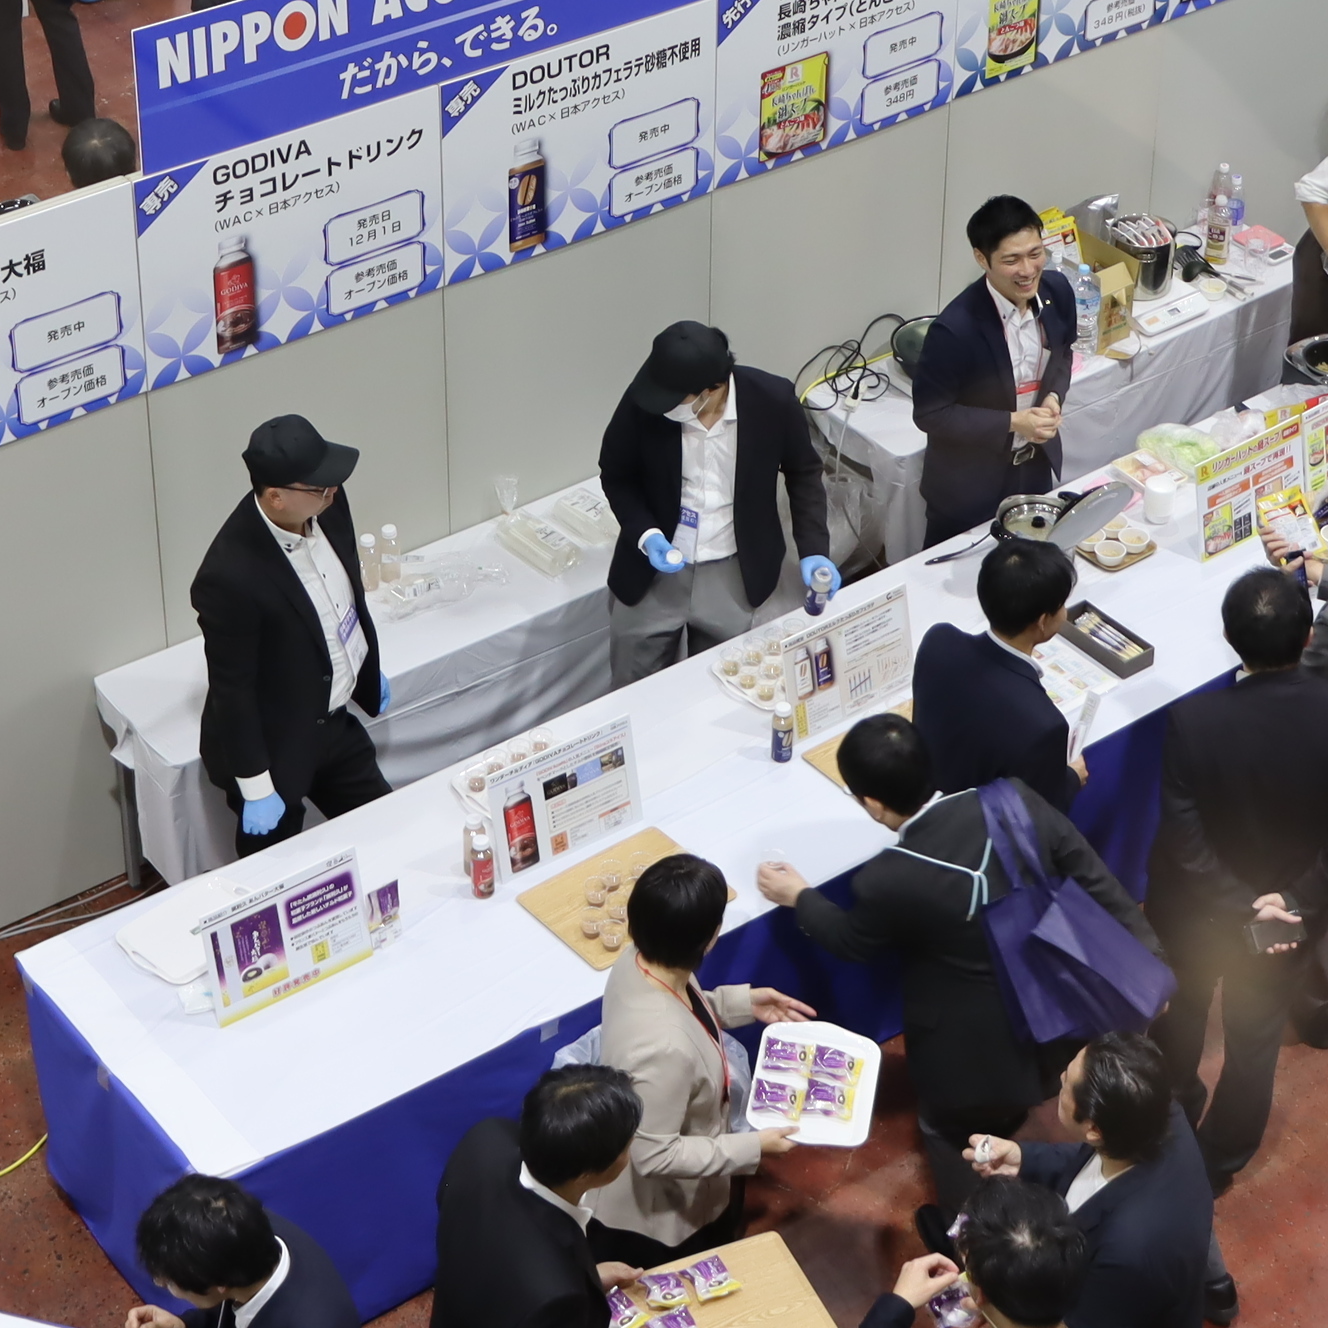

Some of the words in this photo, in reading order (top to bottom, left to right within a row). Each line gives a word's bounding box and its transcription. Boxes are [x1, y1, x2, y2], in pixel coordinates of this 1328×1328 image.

[859, 0, 916, 30] 日本アクセス)
[1093, 3, 1146, 30] 348円(税抜)
[338, 4, 558, 101] だから、できる。
[889, 35, 917, 54] 発売中
[511, 43, 611, 91] DOUTOR
[512, 36, 701, 116] ミルクたっぷりカフェラテ砂糖不使用
[444, 79, 482, 118] 専売
[884, 74, 918, 96] 参考売価
[885, 89, 915, 108] 348円
[560, 87, 626, 121] 日本アクセス)
[638, 123, 670, 143] 発売中
[212, 139, 313, 186] GODIVA
[215, 127, 424, 213] チョコレートドリンク
[634, 163, 674, 186] 参考売価
[139, 175, 179, 216] 専売
[268, 181, 341, 215] 日本アクセス)
[624, 174, 683, 204] オープン価格
[347, 220, 402, 248] 12月1日
[356, 209, 392, 232] 発売日
[343, 269, 409, 301] オープン価格
[353, 259, 398, 284] 参考売価
[219, 281, 249, 297] GODIVA
[46, 321, 86, 343] 発売中
[37, 374, 108, 409] オープン価格
[47, 364, 95, 391] 参考売価
